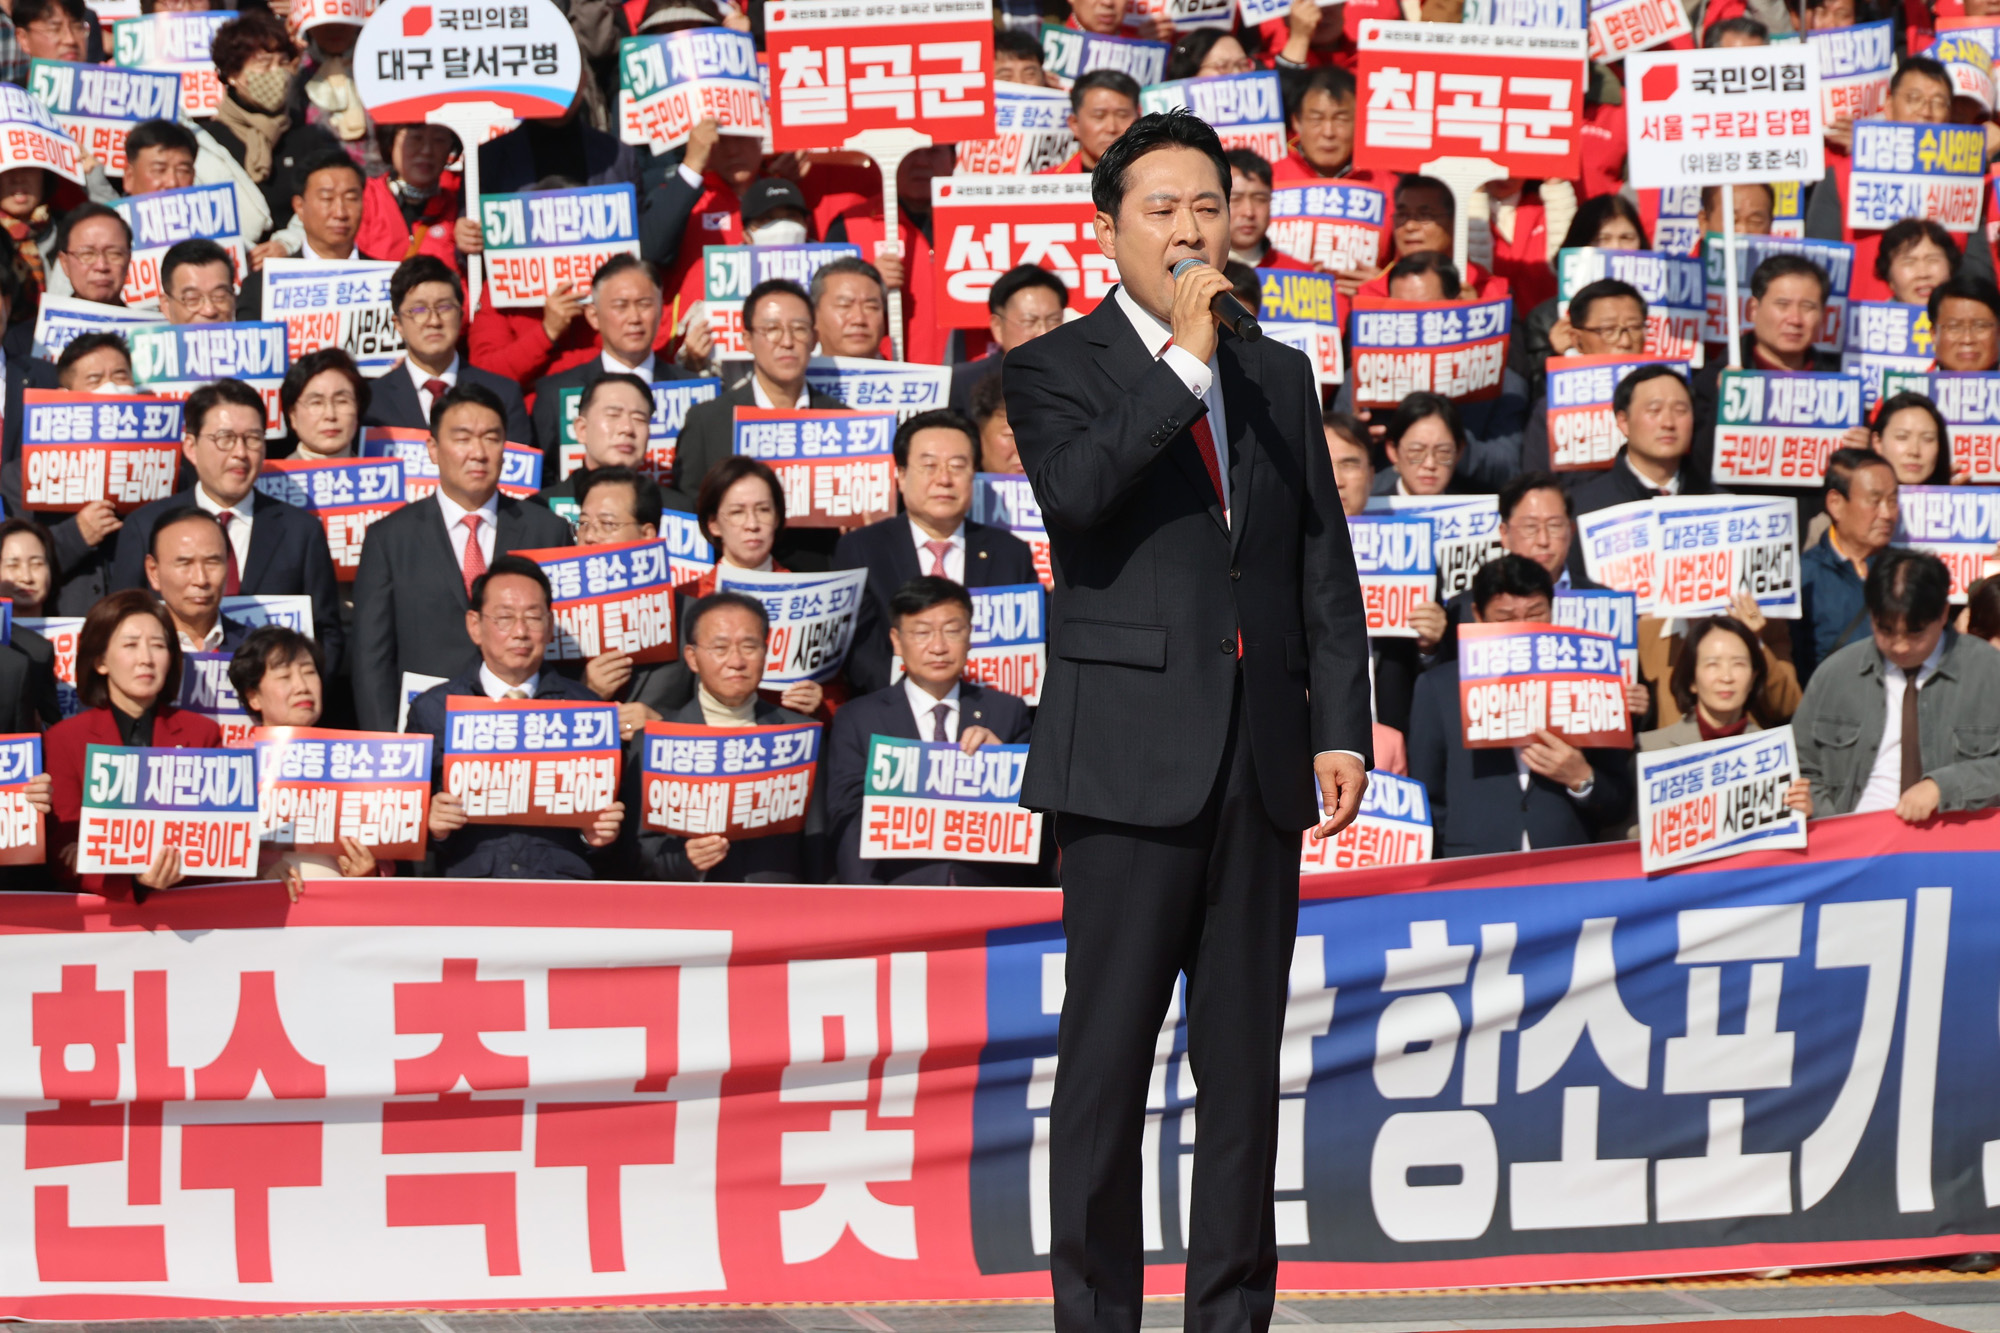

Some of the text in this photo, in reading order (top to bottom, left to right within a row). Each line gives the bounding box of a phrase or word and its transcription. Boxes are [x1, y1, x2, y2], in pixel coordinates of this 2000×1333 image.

[117, 18, 223, 65] 5개 재판
[439, 7, 529, 30] 국민의힘
[1605, 0, 1679, 51] 명령이다
[377, 43, 558, 79] 대구 달서구병
[627, 33, 758, 96] 5개 재판재개
[1043, 30, 1083, 76] 5개
[33, 65, 177, 121] 5개 재판재개
[182, 71, 223, 109] 명령
[778, 41, 986, 126] 칠곡군
[1189, 76, 1280, 123] 재판재개
[1692, 64, 1806, 94] 국민의힘
[643, 90, 694, 143] 국민의
[1021, 105, 1055, 128] 항소
[1366, 67, 1573, 154] 칠곡군
[1641, 115, 1682, 141] 서울
[1692, 112, 1758, 138] 구로갑
[1766, 109, 1811, 136] 당협
[9, 129, 77, 175] 명령이다
[1681, 149, 1808, 173] (위원장 호준석)
[1856, 127, 1984, 173] 대장동 수사외압
[136, 187, 238, 242] 재판재개
[484, 193, 632, 246] 5개 재판재개
[1304, 187, 1383, 222] 항소 포기
[1855, 183, 1979, 224] 국정조사 실시하라
[272, 280, 371, 308] 대장동 항소
[492, 257, 546, 298] 국민의
[708, 251, 751, 297] 5개
[1262, 275, 1333, 320] 수사외압
[1611, 256, 1703, 304] 재판재개
[1358, 303, 1506, 346] 대장동 항소 포기
[1852, 306, 1908, 349] 대장동
[184, 328, 284, 377] 재판재개
[1357, 352, 1430, 402] 외압실체
[1434, 343, 1502, 400] 특검하라
[858, 380, 938, 404] 항소 포기
[1555, 371, 1611, 404] 대장동
[1723, 376, 1766, 422] 5개
[1769, 376, 1860, 424] 재판재개
[30, 405, 179, 441] 대장동 항소 포기
[740, 418, 889, 457] 대장동 항소 포기
[1554, 409, 1621, 465] 외압실
[27, 447, 176, 503] 외압실체 특검하라
[1721, 434, 1842, 477] 국민의 명령이
[312, 469, 353, 502] 항소
[358, 465, 399, 500] 포기
[814, 464, 890, 516] 특검하라
[992, 480, 1042, 526] 재판
[1349, 522, 1431, 571] 판재개
[1664, 511, 1793, 550] 대장동 항소 포기
[586, 553, 628, 592] 항소
[631, 545, 667, 584] 포기
[1663, 542, 1794, 606] 사법정의 사망선고
[602, 590, 672, 654] 특검하라
[790, 592, 823, 621] 항소
[827, 584, 854, 613] 포기
[970, 591, 1039, 642] 판재개
[1468, 637, 1531, 675] 대장동
[1537, 635, 1577, 670] 항소
[1580, 635, 1617, 671] 포기
[452, 711, 613, 750] 대장동 항소 포기
[1467, 679, 1626, 741] 외압실체 특검하라
[261, 743, 425, 779] 대장동 항소 포기
[651, 729, 814, 773] 대장동 항소 포기
[872, 743, 921, 792] 5개
[1650, 742, 1790, 805] 대장동 항소 포기
[89, 753, 254, 805] 5개 재판재개
[449, 756, 615, 816] 외압실체 특검하라
[648, 769, 810, 833] 외압실체 특검하라
[259, 788, 423, 847] 외압실체 특검하라
[870, 805, 1033, 854] 국민의 명령이다
[1650, 773, 1792, 857] 사법정의 사망선고
[87, 819, 154, 866] 국민의
[1336, 823, 1425, 868] 명령이다
[24, 963, 327, 1283] 환수
[381, 957, 683, 1277] 촉구
[778, 952, 928, 1264] 및
[1370, 887, 1953, 1242] 항소포기
